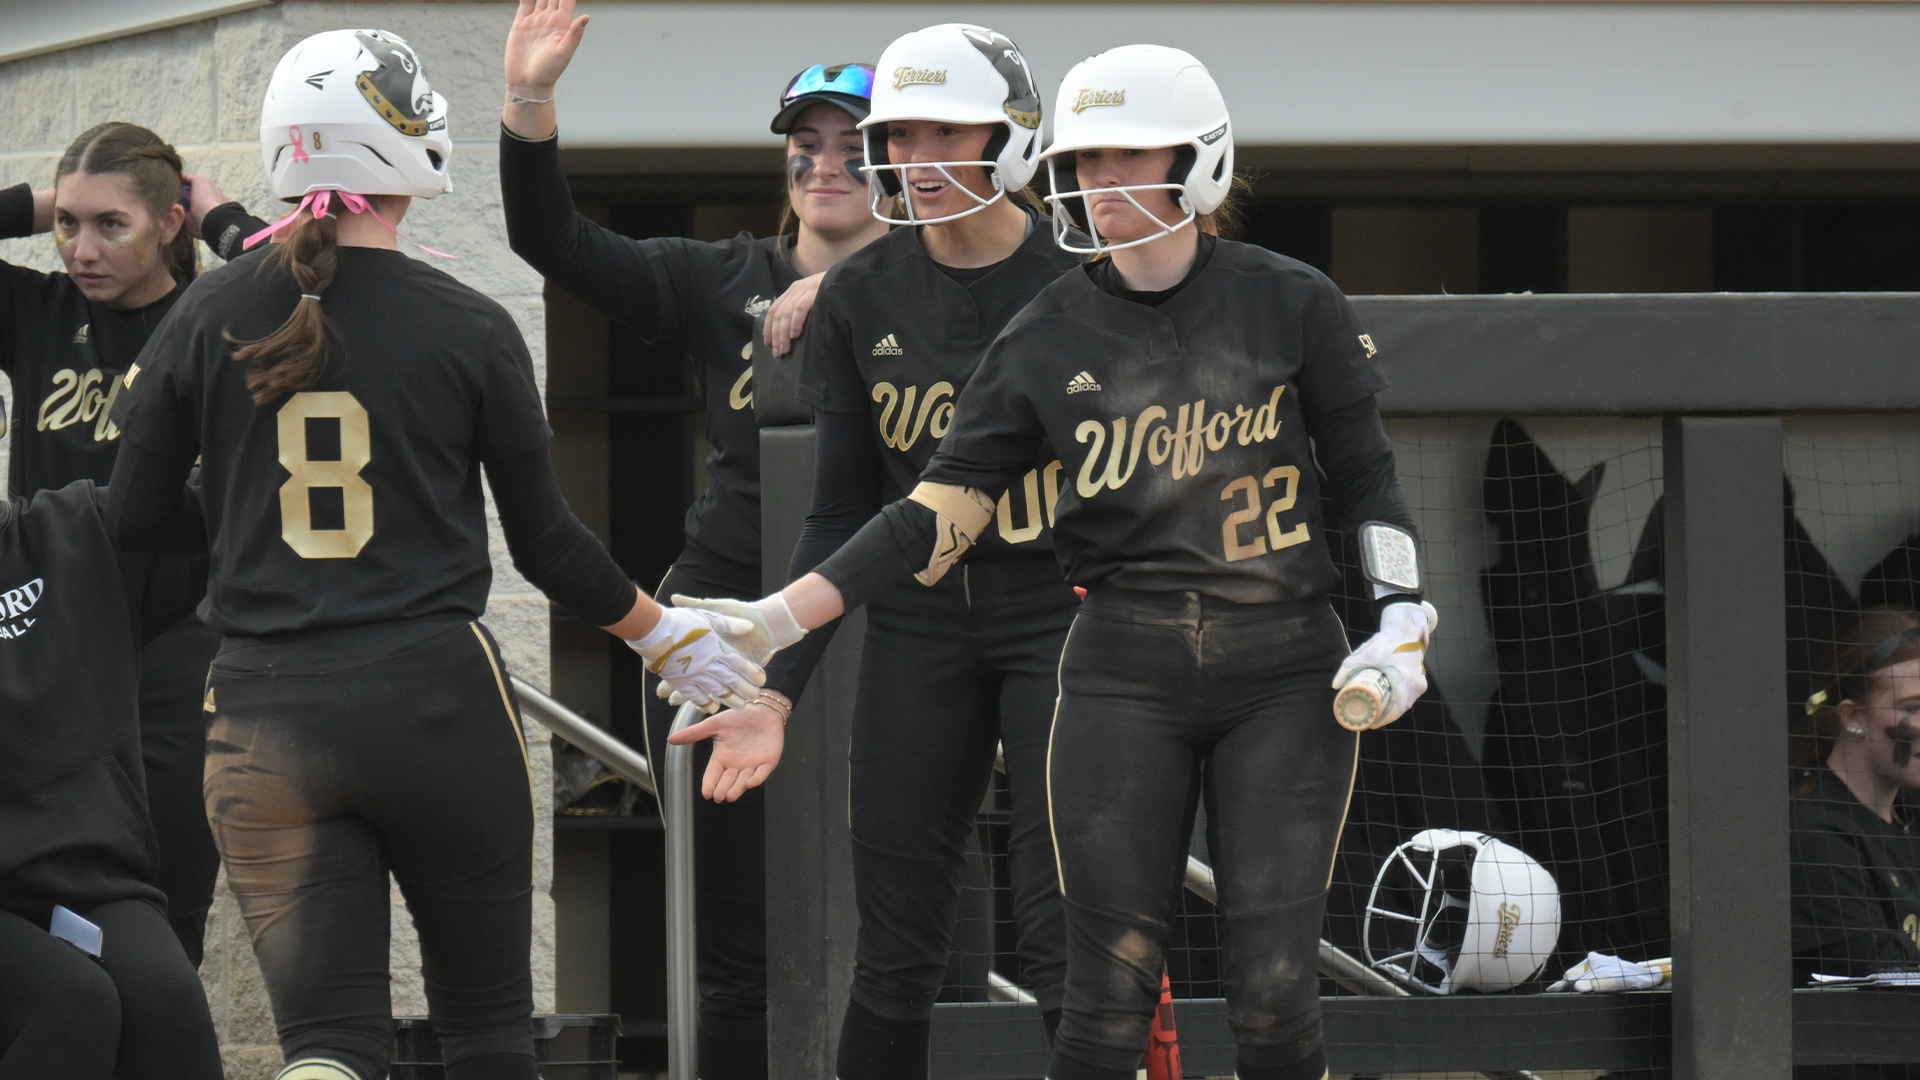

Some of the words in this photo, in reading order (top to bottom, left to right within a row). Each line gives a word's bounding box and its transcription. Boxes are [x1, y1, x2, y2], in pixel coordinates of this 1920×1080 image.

[892, 66, 948, 91] Terriers
[1071, 88, 1125, 114] Terriers
[312, 131, 322, 150] 8
[1203, 126, 1225, 142] EASTON
[872, 346, 903, 356] adidas
[1066, 382, 1102, 395] adidas
[1075, 385, 1286, 498] Wofford
[276, 391, 374, 559] 8
[1220, 465, 1311, 562] 22
[1493, 902, 1521, 959] Terriers
